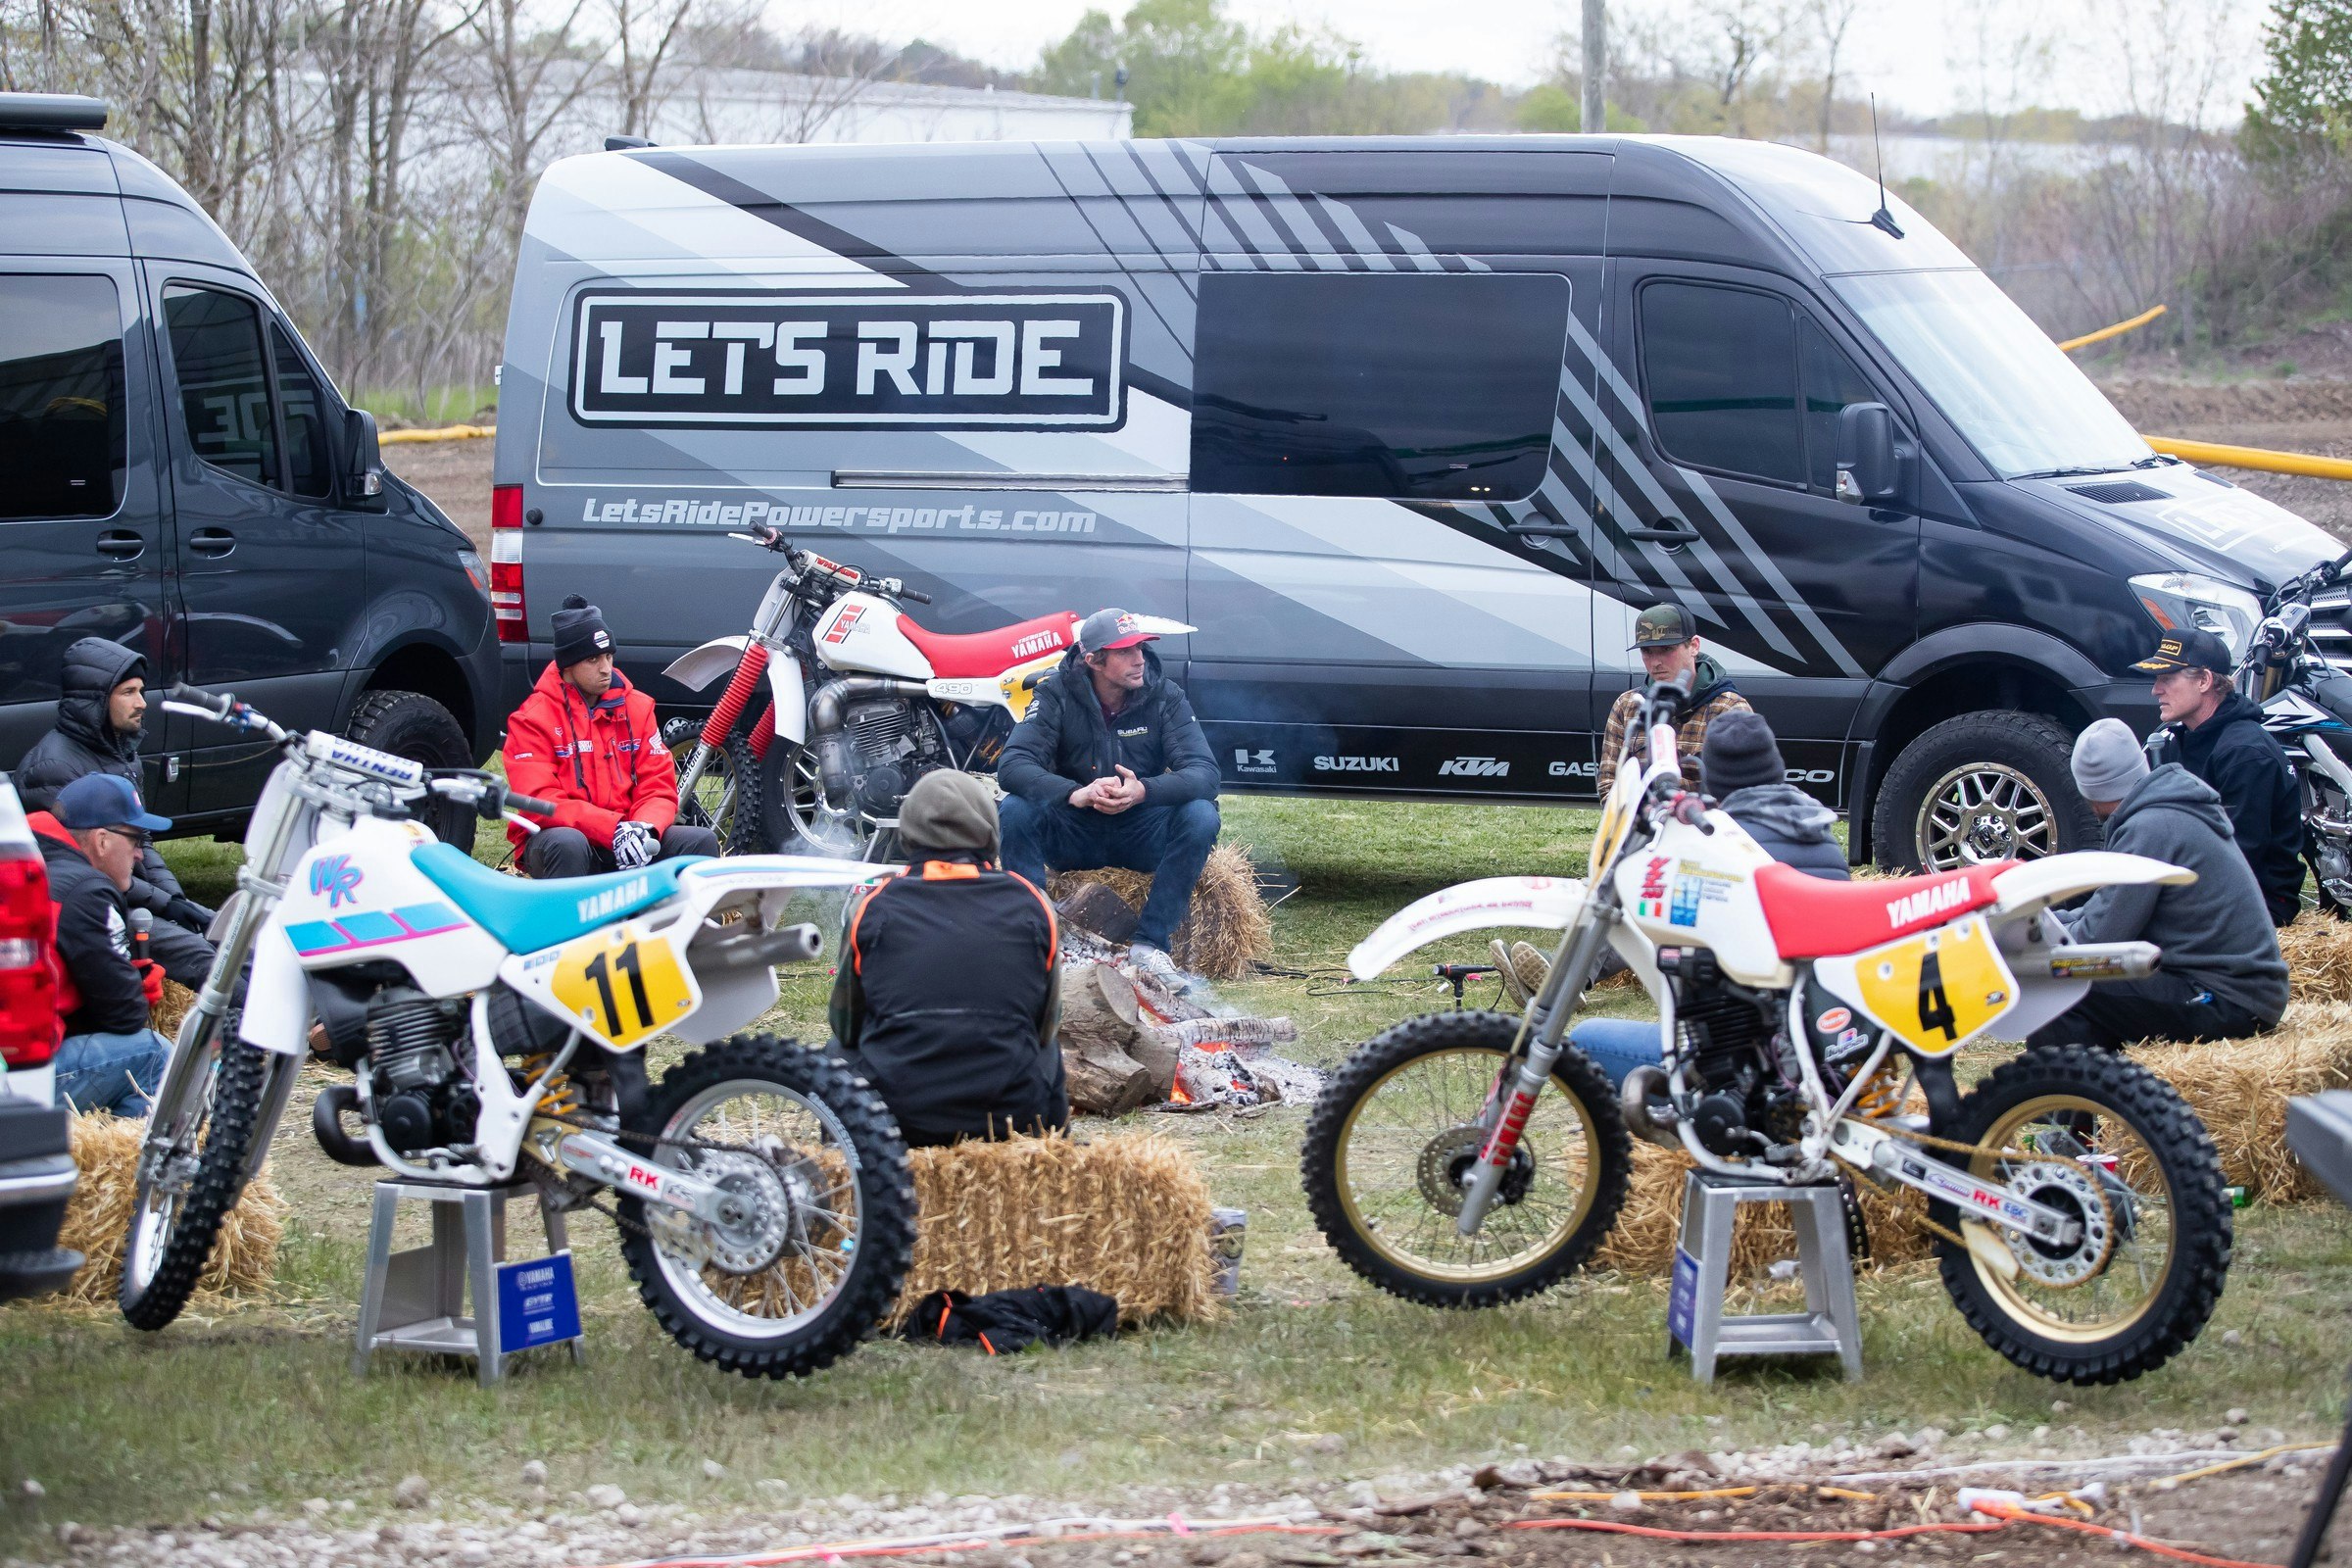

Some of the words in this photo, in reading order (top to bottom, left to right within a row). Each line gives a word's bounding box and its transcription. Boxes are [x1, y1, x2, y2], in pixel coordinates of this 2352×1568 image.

[857, 319, 1095, 396] RIDE
[582, 497, 1098, 535] LetsRidePowersports.com
[840, 619, 870, 634] YAMAHA
[1010, 631, 1063, 659] YAMAHA
[935, 683, 973, 695] 490
[1117, 726, 1148, 735] SUBARU
[1237, 764, 1277, 773] Kawasaki
[1314, 757, 1399, 772] SUZUKI
[1438, 757, 1510, 777] KTM
[309, 854, 366, 908] WR
[576, 876, 650, 924] YAMAHA
[1886, 876, 1972, 930] YAMAHA
[584, 941, 655, 1038] 11
[1917, 950, 1959, 1042] 4
[629, 1165, 661, 1191] RK
[1973, 1187, 2001, 1210] RK
